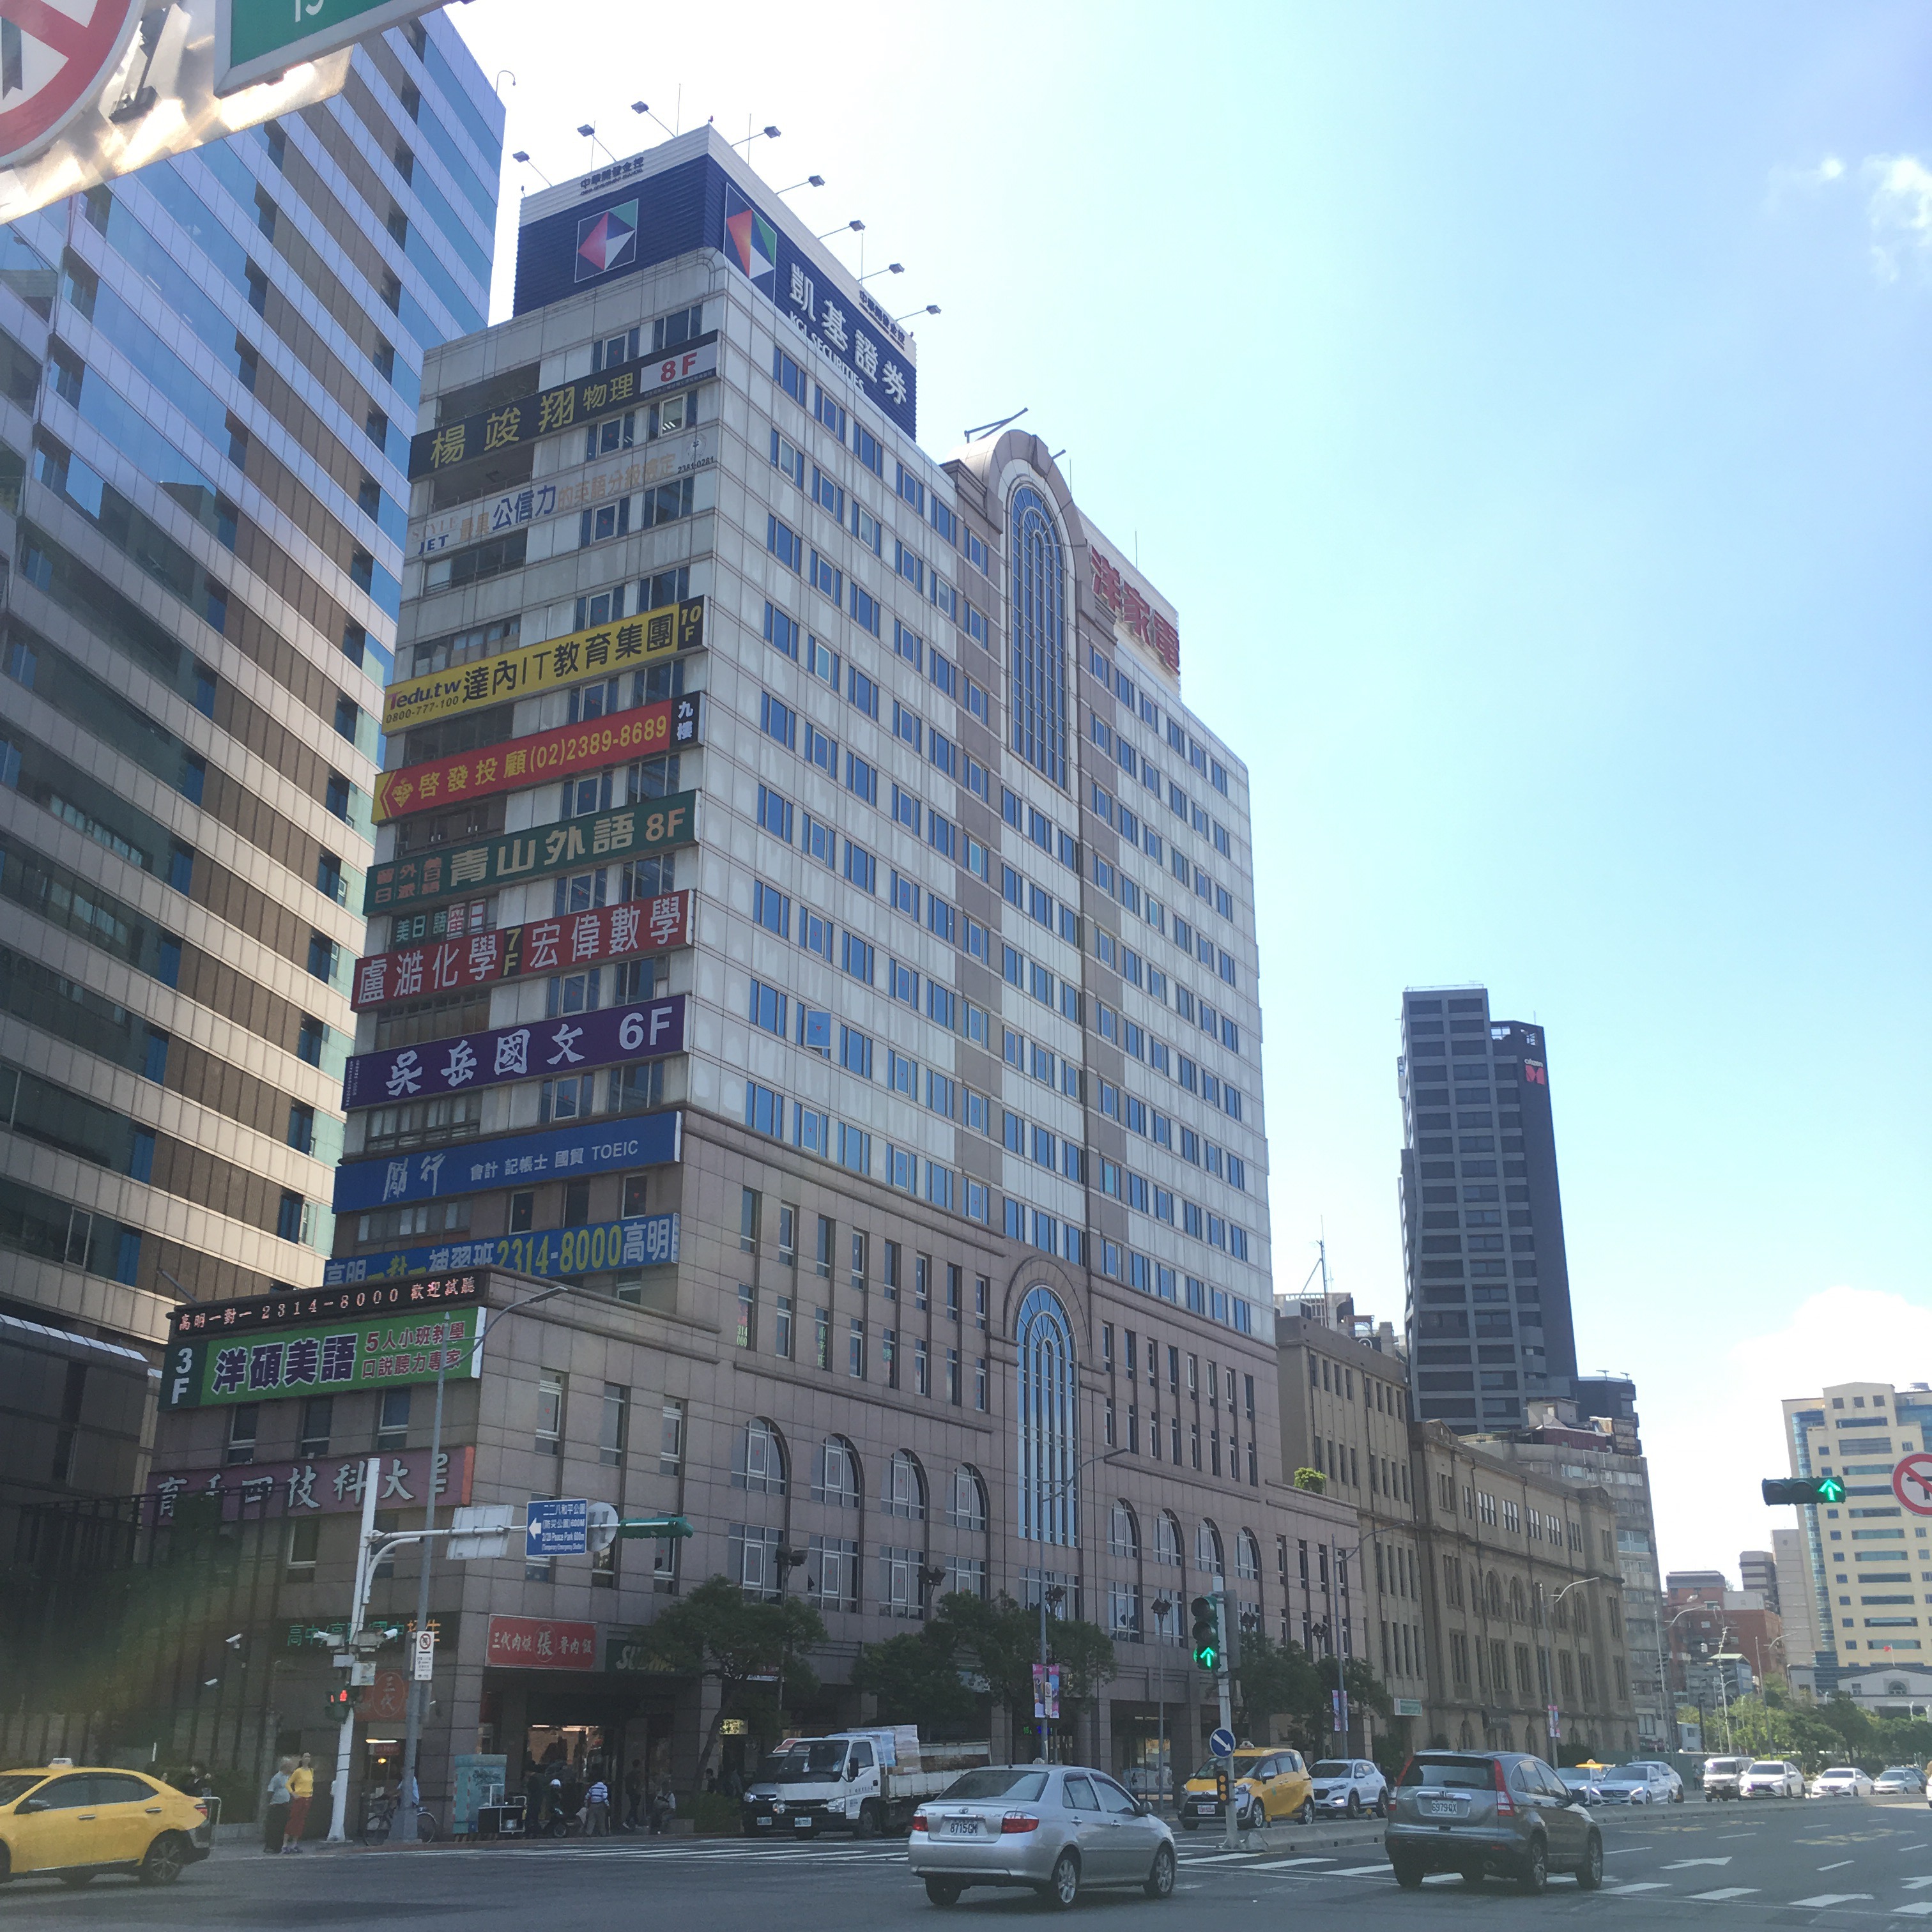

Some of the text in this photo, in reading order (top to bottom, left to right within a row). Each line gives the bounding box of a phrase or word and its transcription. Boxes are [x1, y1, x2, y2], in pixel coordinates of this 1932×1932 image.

[789, 263, 907, 404] 凱基證券
[431, 386, 575, 468] 楊竣翔
[583, 372, 634, 411] 物理
[661, 352, 697, 382] 8F
[418, 534, 449, 555] JET
[462, 613, 675, 703] 達內IT教育集團
[386, 696, 459, 724] 0800-777-100
[530, 715, 668, 771] (02)2389-8689
[450, 808, 686, 886] 青山外語 8F
[530, 896, 680, 970] 宏偉數學
[386, 1023, 585, 1096] 吳岳國文
[619, 1006, 673, 1050] 6F
[471, 1162, 498, 1181] 會計
[505, 1155, 548, 1177] 記帳士
[592, 1140, 638, 1161] TOEIC
[497, 1225, 622, 1275] 2314-8000
[622, 1218, 670, 1264] 高明
[211, 1333, 358, 1395] 洋碩美語
